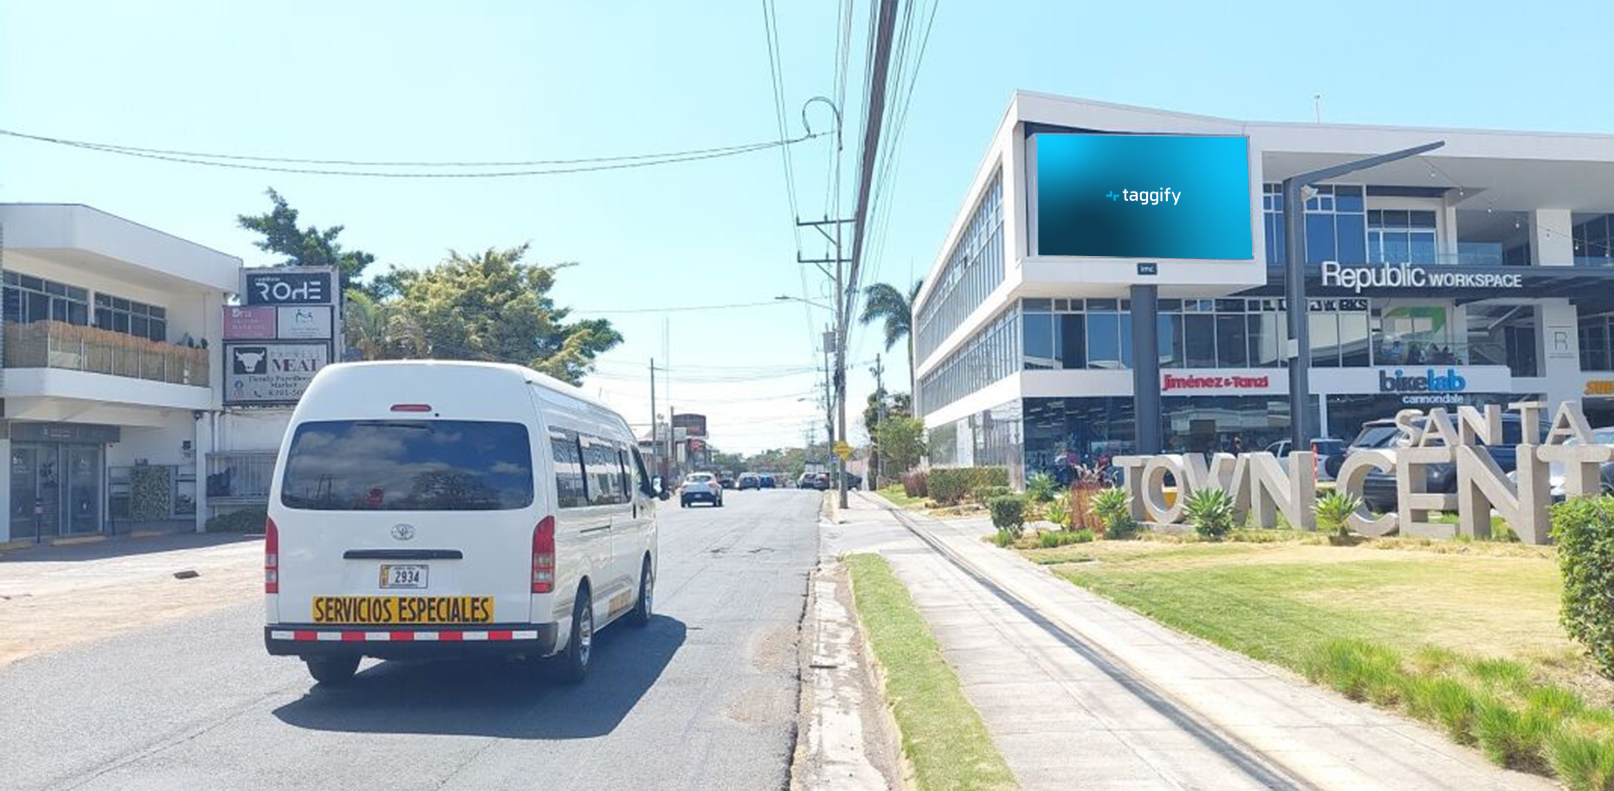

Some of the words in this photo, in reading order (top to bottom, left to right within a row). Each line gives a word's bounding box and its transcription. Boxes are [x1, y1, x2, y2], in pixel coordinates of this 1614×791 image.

[1122, 187, 1181, 205] taggify
[1322, 261, 1425, 293] Republic
[1428, 273, 1522, 287] WORKSPACE
[1162, 374, 1223, 391] Jiménez
[1232, 375, 1269, 388] Tanzi
[1379, 369, 1465, 392] bikelab
[1402, 394, 1464, 404] cannondale
[1395, 401, 1596, 447] SANTA
[1113, 452, 1317, 531] TOWN
[395, 571, 419, 583] 2934
[315, 597, 391, 622] SERVICIOS
[399, 597, 488, 622] ESPECIALES
